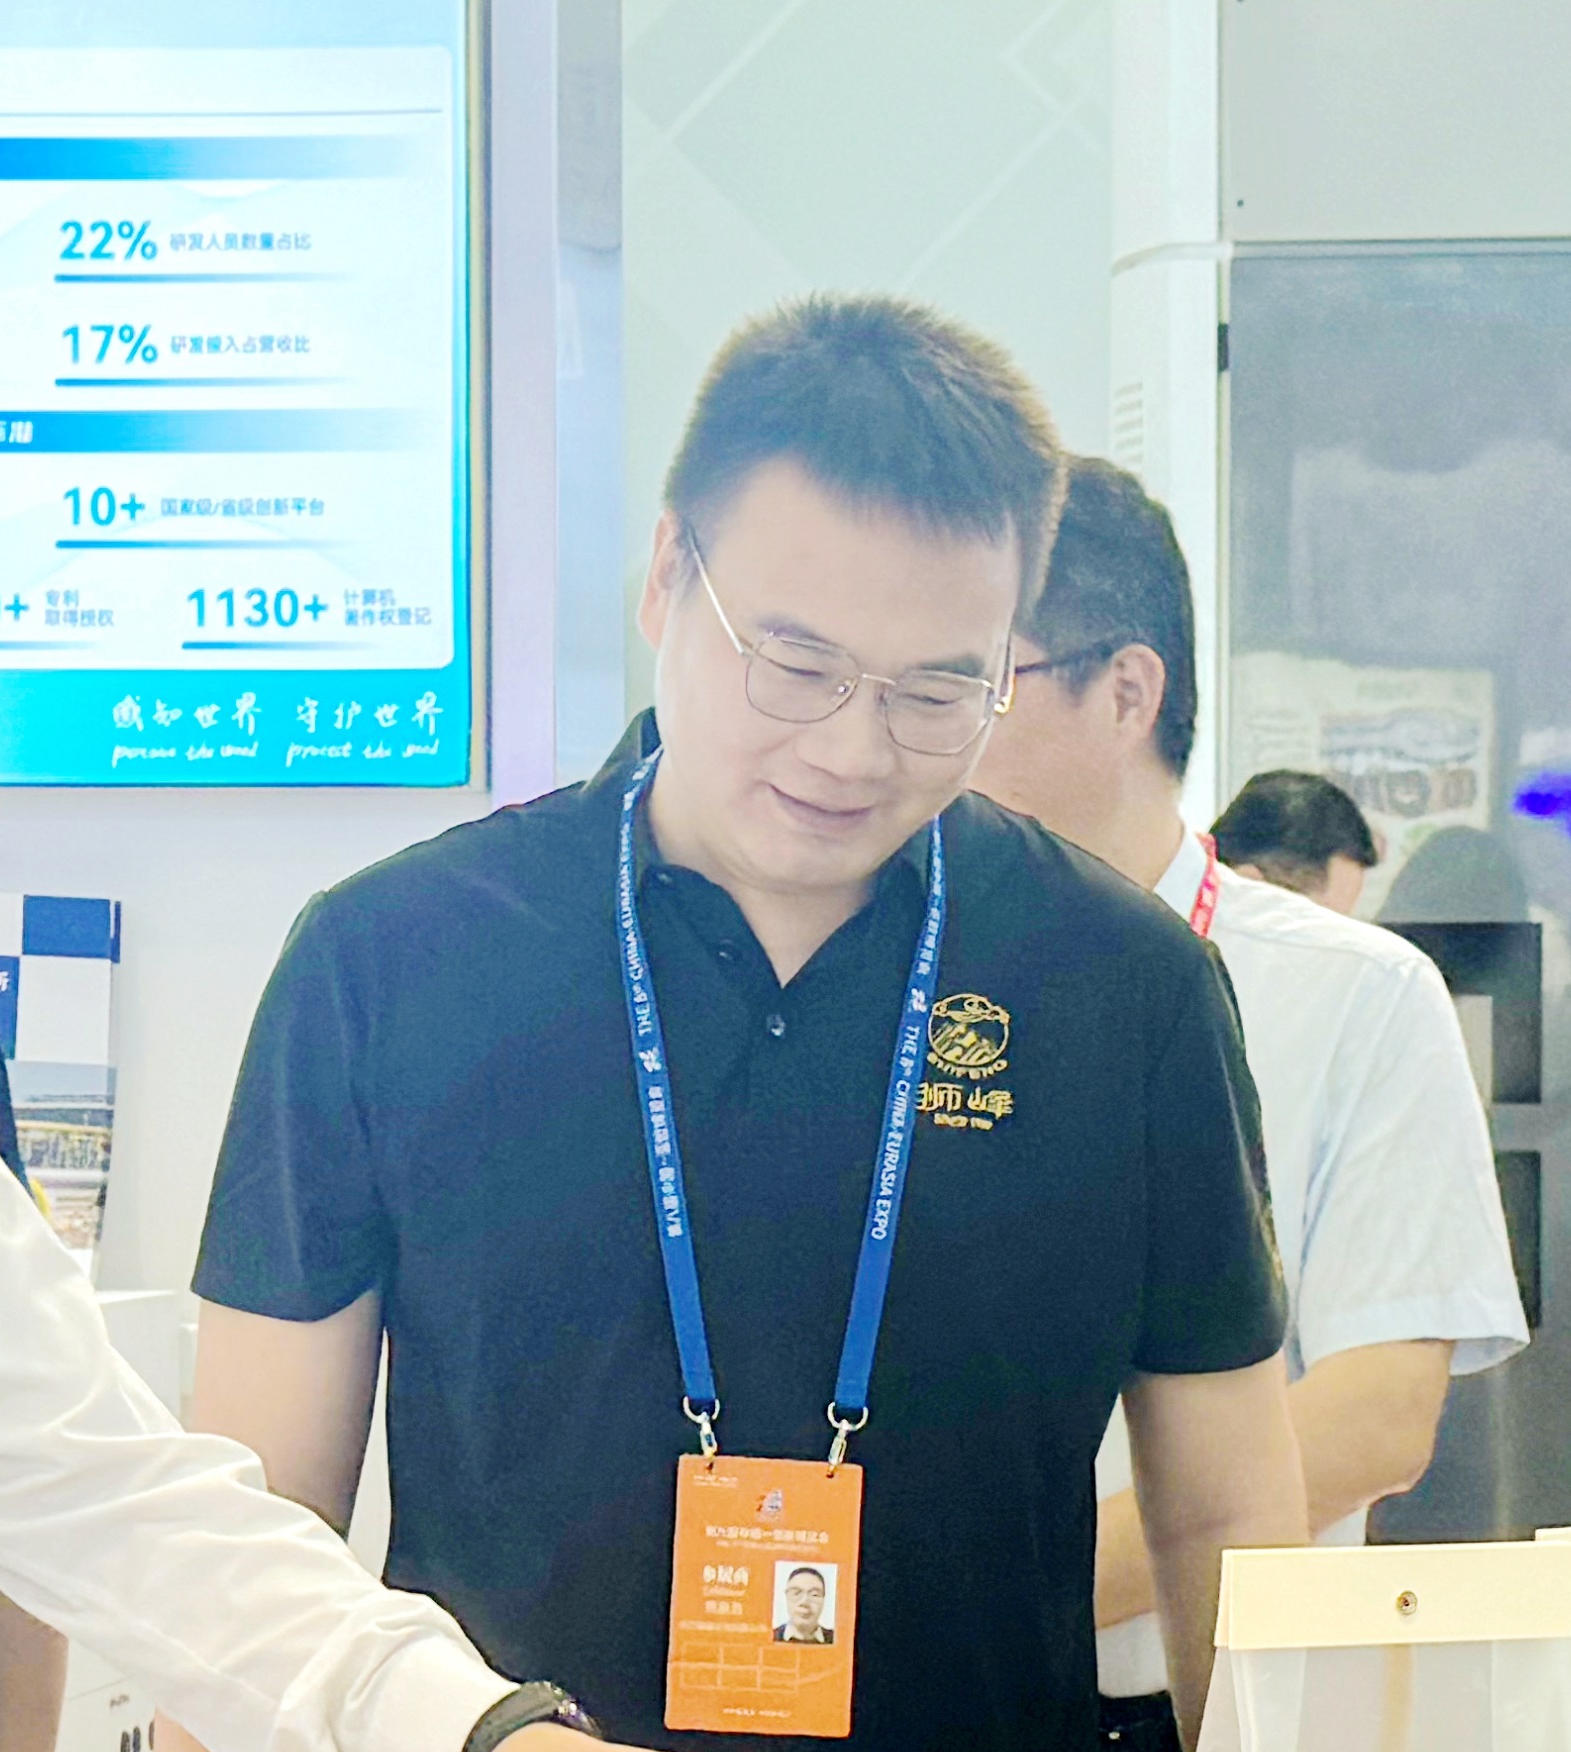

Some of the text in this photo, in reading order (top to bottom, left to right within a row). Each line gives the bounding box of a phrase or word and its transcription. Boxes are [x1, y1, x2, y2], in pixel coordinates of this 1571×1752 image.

[59, 220, 158, 261] 22%
[62, 324, 158, 364] 17%
[63, 486, 146, 527] 10+
[186, 588, 329, 629] 1130+
[915, 1081, 1014, 1119] 狮峰
[869, 1198, 890, 1240] EXPO
